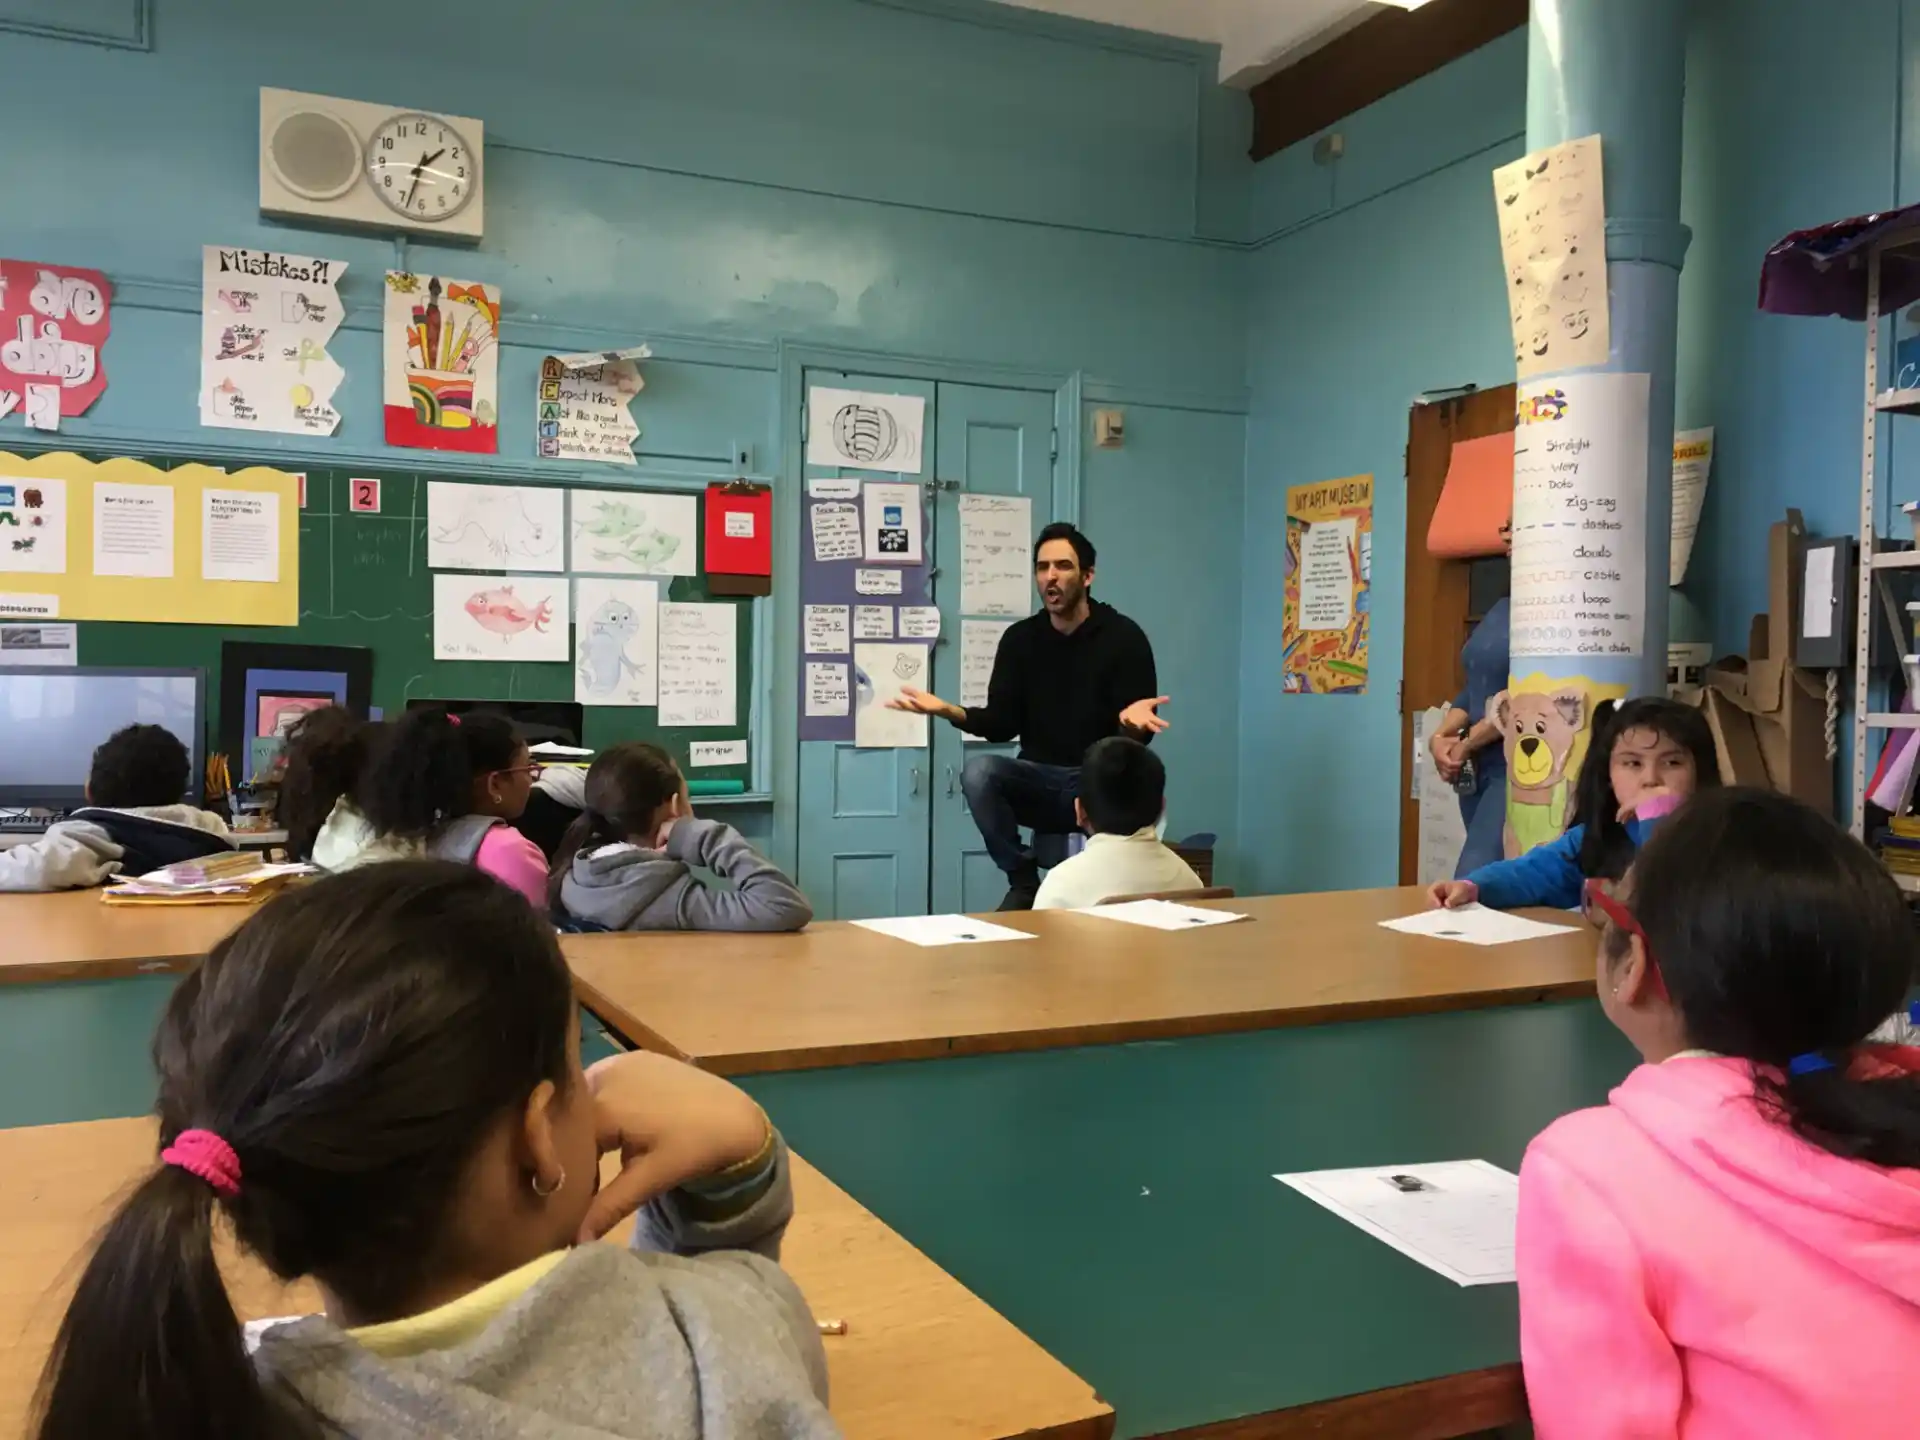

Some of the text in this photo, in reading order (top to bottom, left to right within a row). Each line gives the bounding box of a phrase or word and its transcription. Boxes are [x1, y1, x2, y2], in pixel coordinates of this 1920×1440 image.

[397, 125, 407, 138] 11
[415, 122, 428, 135] 12
[382, 137, 394, 150] 10
[452, 147, 459, 159] 2
[378, 156, 386, 169] 9
[458, 167, 465, 178] 3
[384, 175, 392, 187] 8
[398, 190, 406, 202] 7
[452, 185, 459, 196] 4
[418, 199, 425, 211] 6
[438, 196, 446, 207] 5
[219, 250, 330, 284] Mistakes?!
[358, 485, 373, 506] 2
[1309, 489, 1328, 509] ART
[1329, 483, 1370, 506] MUSEUM
[1582, 518, 1624, 530] dashes
[1573, 545, 1613, 559] clouds
[1583, 570, 1621, 582] castle
[1582, 592, 1612, 605] loops
[1574, 611, 1610, 621] mouse
[1577, 642, 1632, 655] circle chain
